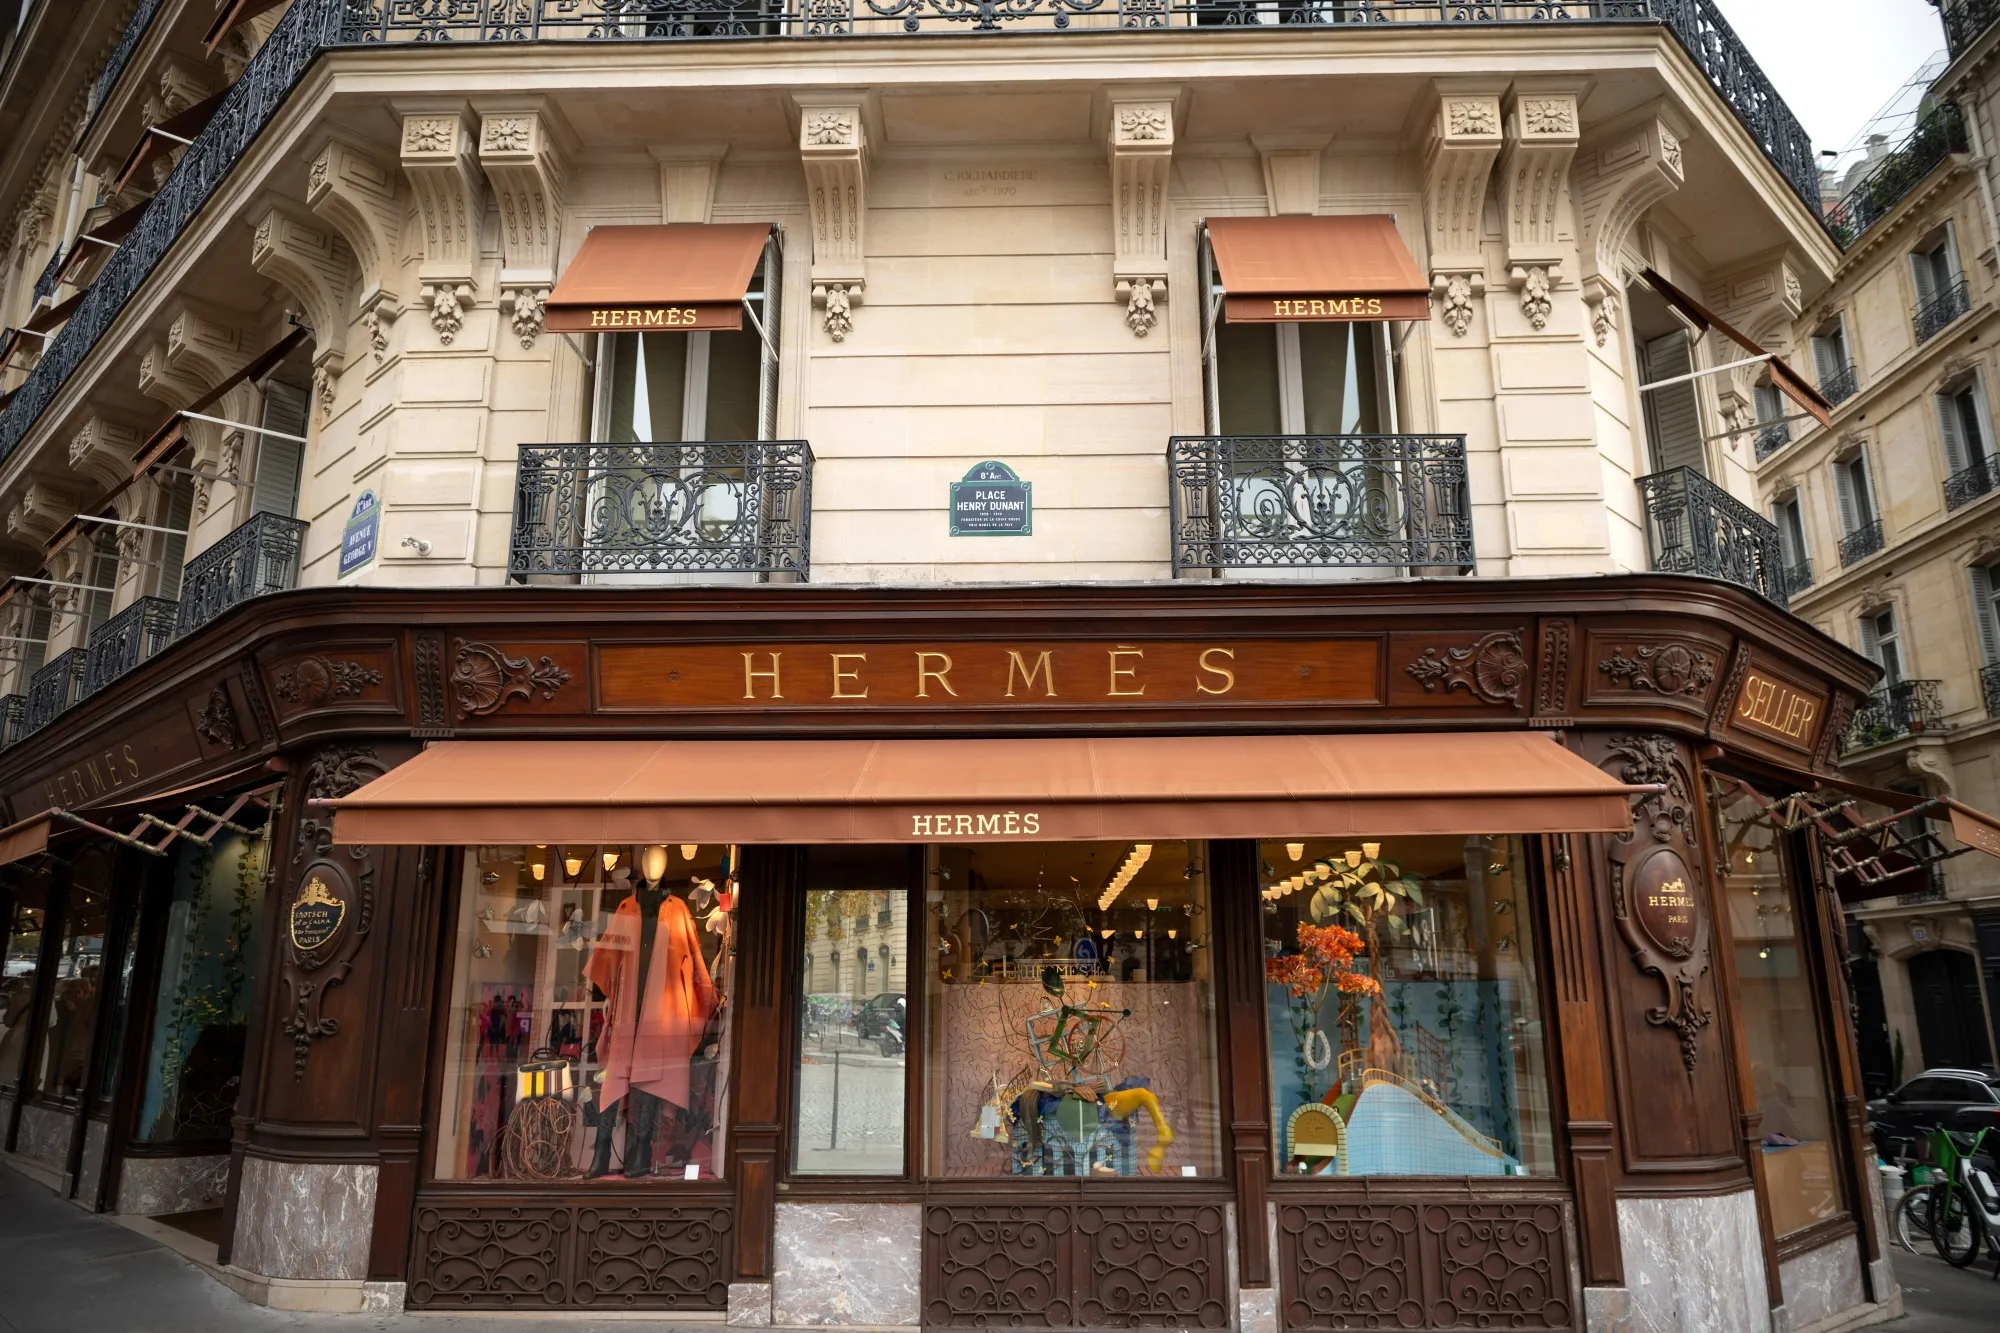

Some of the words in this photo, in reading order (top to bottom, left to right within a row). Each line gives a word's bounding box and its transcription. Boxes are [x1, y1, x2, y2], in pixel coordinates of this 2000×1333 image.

[590, 307, 697, 326] HERMÈS
[1273, 297, 1382, 315] HERMÈS
[957, 502, 987, 511] HENRY
[990, 501, 1024, 511] DUNANT
[976, 491, 1006, 500] PLACE
[349, 524, 372, 547] AVENUE
[343, 543, 367, 565] GEORGE
[367, 540, 373, 551] V
[740, 645, 1236, 699] HERMÈS
[1739, 675, 1815, 740] SELLIER
[912, 811, 1040, 836] HERMÈS
[299, 935, 320, 944] PARIS
